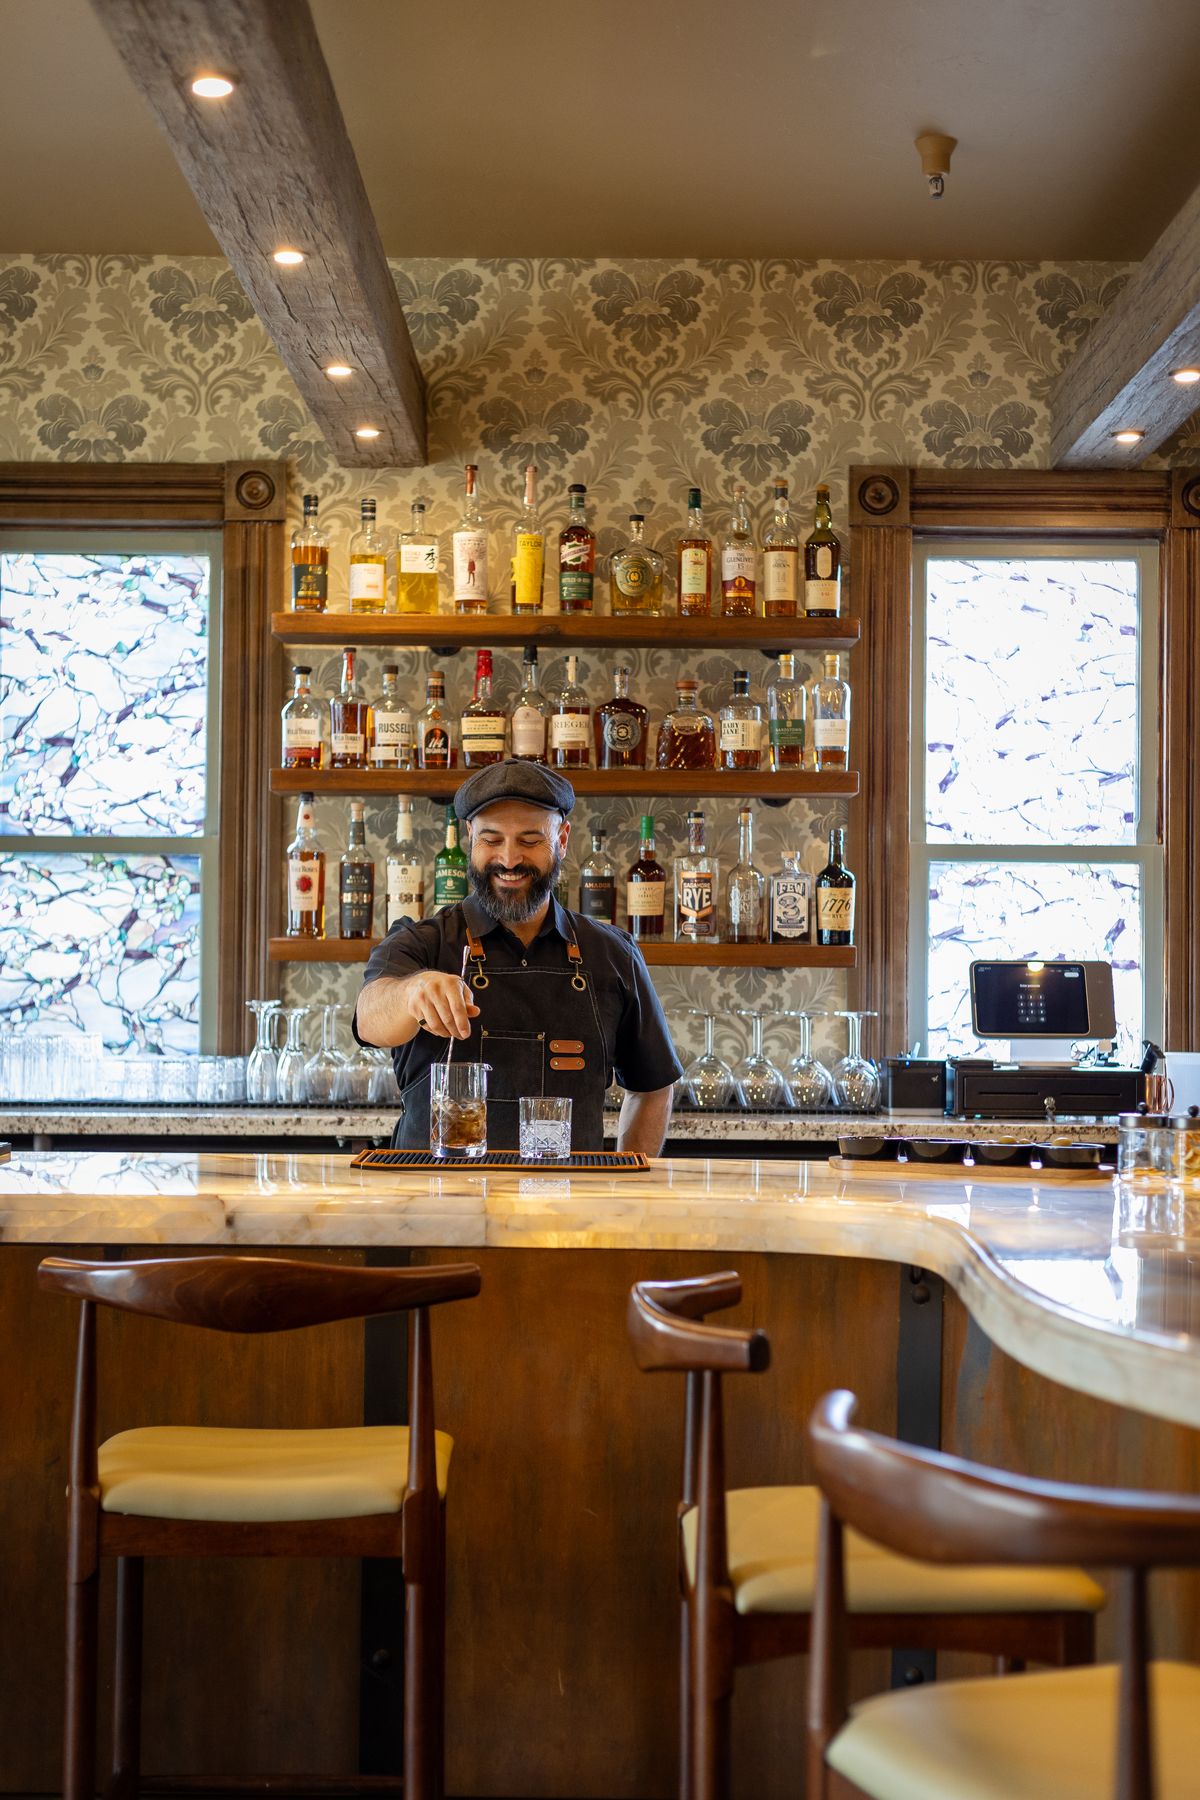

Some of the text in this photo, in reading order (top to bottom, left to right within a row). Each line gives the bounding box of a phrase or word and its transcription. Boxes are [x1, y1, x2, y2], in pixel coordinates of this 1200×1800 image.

[435, 868, 466, 879] JAMESON
[777, 881, 805, 896] FEW
[683, 888, 711, 911] RYE
[821, 898, 853, 913] 1776
